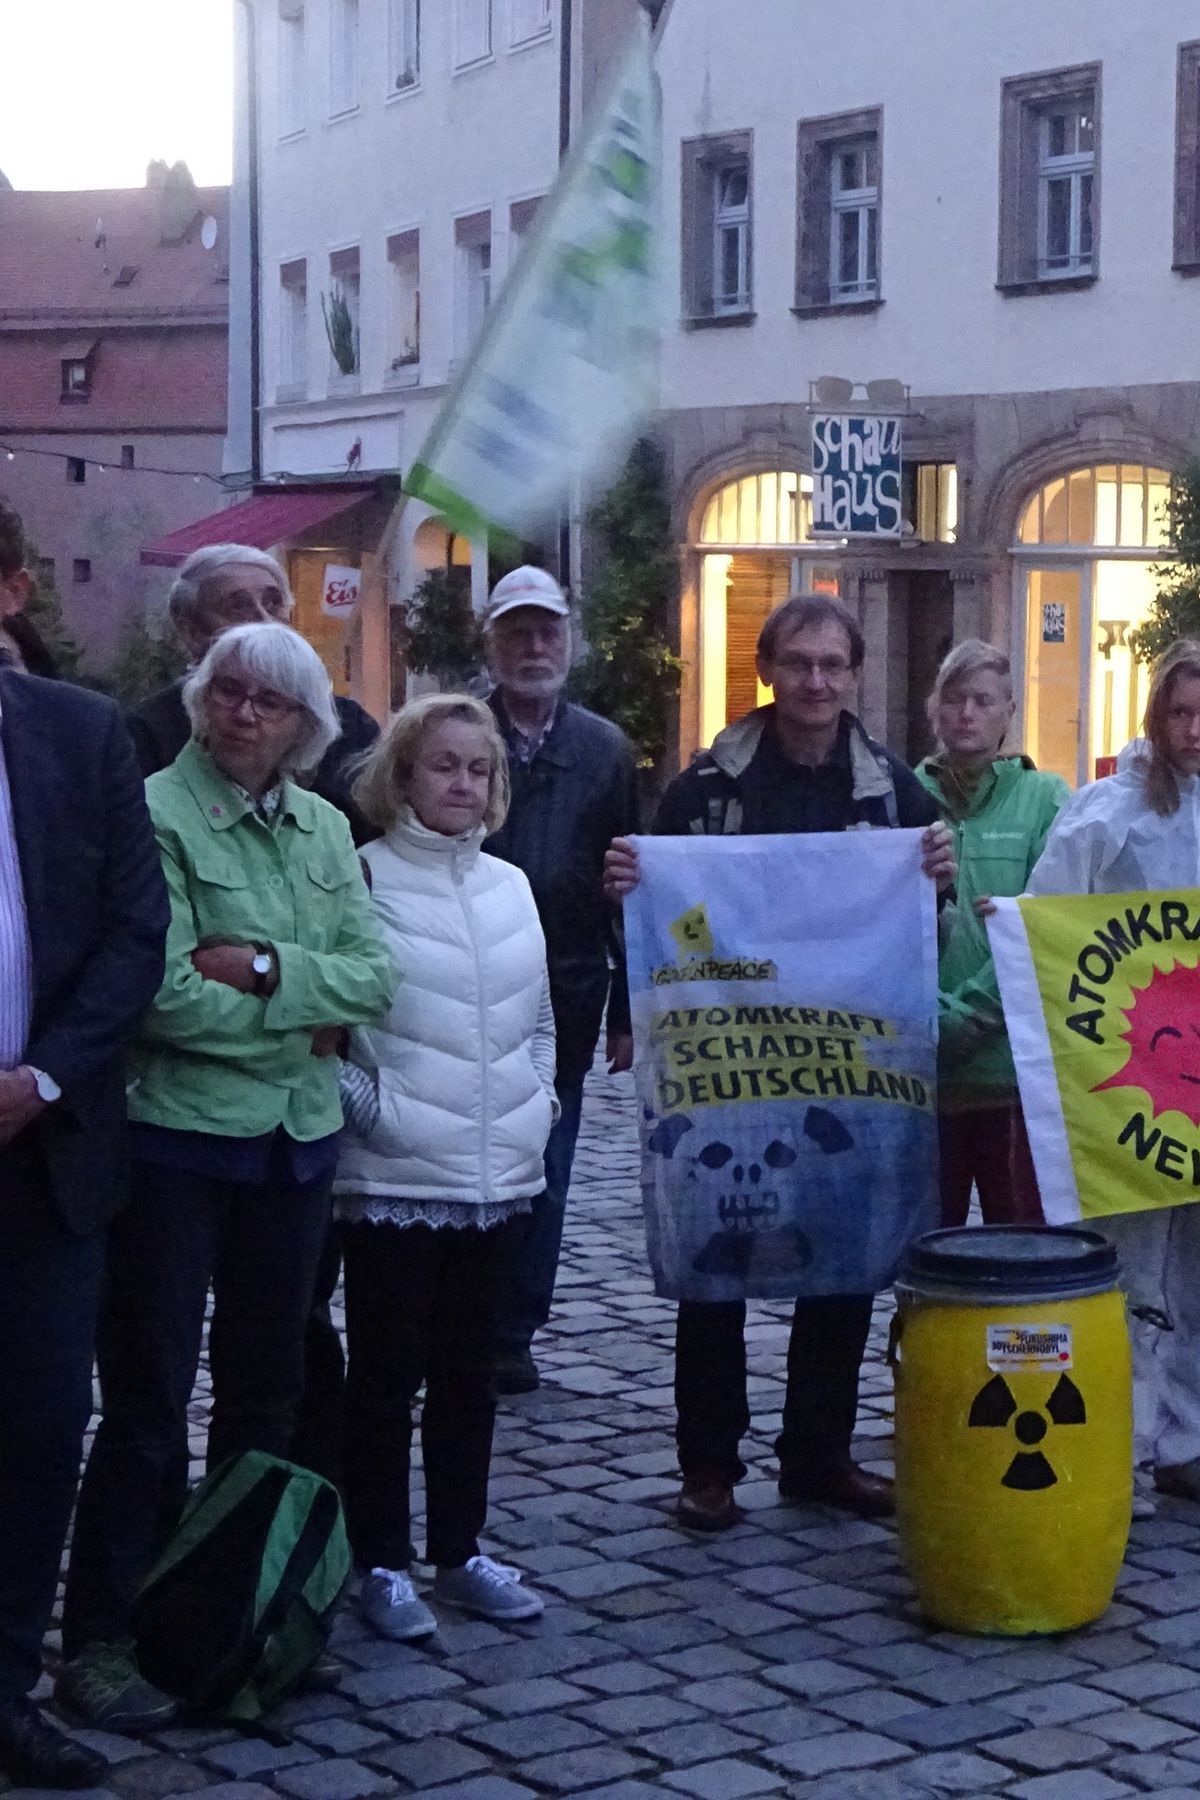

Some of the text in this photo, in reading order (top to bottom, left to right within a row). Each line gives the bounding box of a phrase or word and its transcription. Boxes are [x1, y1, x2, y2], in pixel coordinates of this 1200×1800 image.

[656, 1006, 886, 1036] ATOMKRAFT
[673, 1035, 857, 1066] SCHADET
[659, 1066, 928, 1109] DEUTSCHLAND
